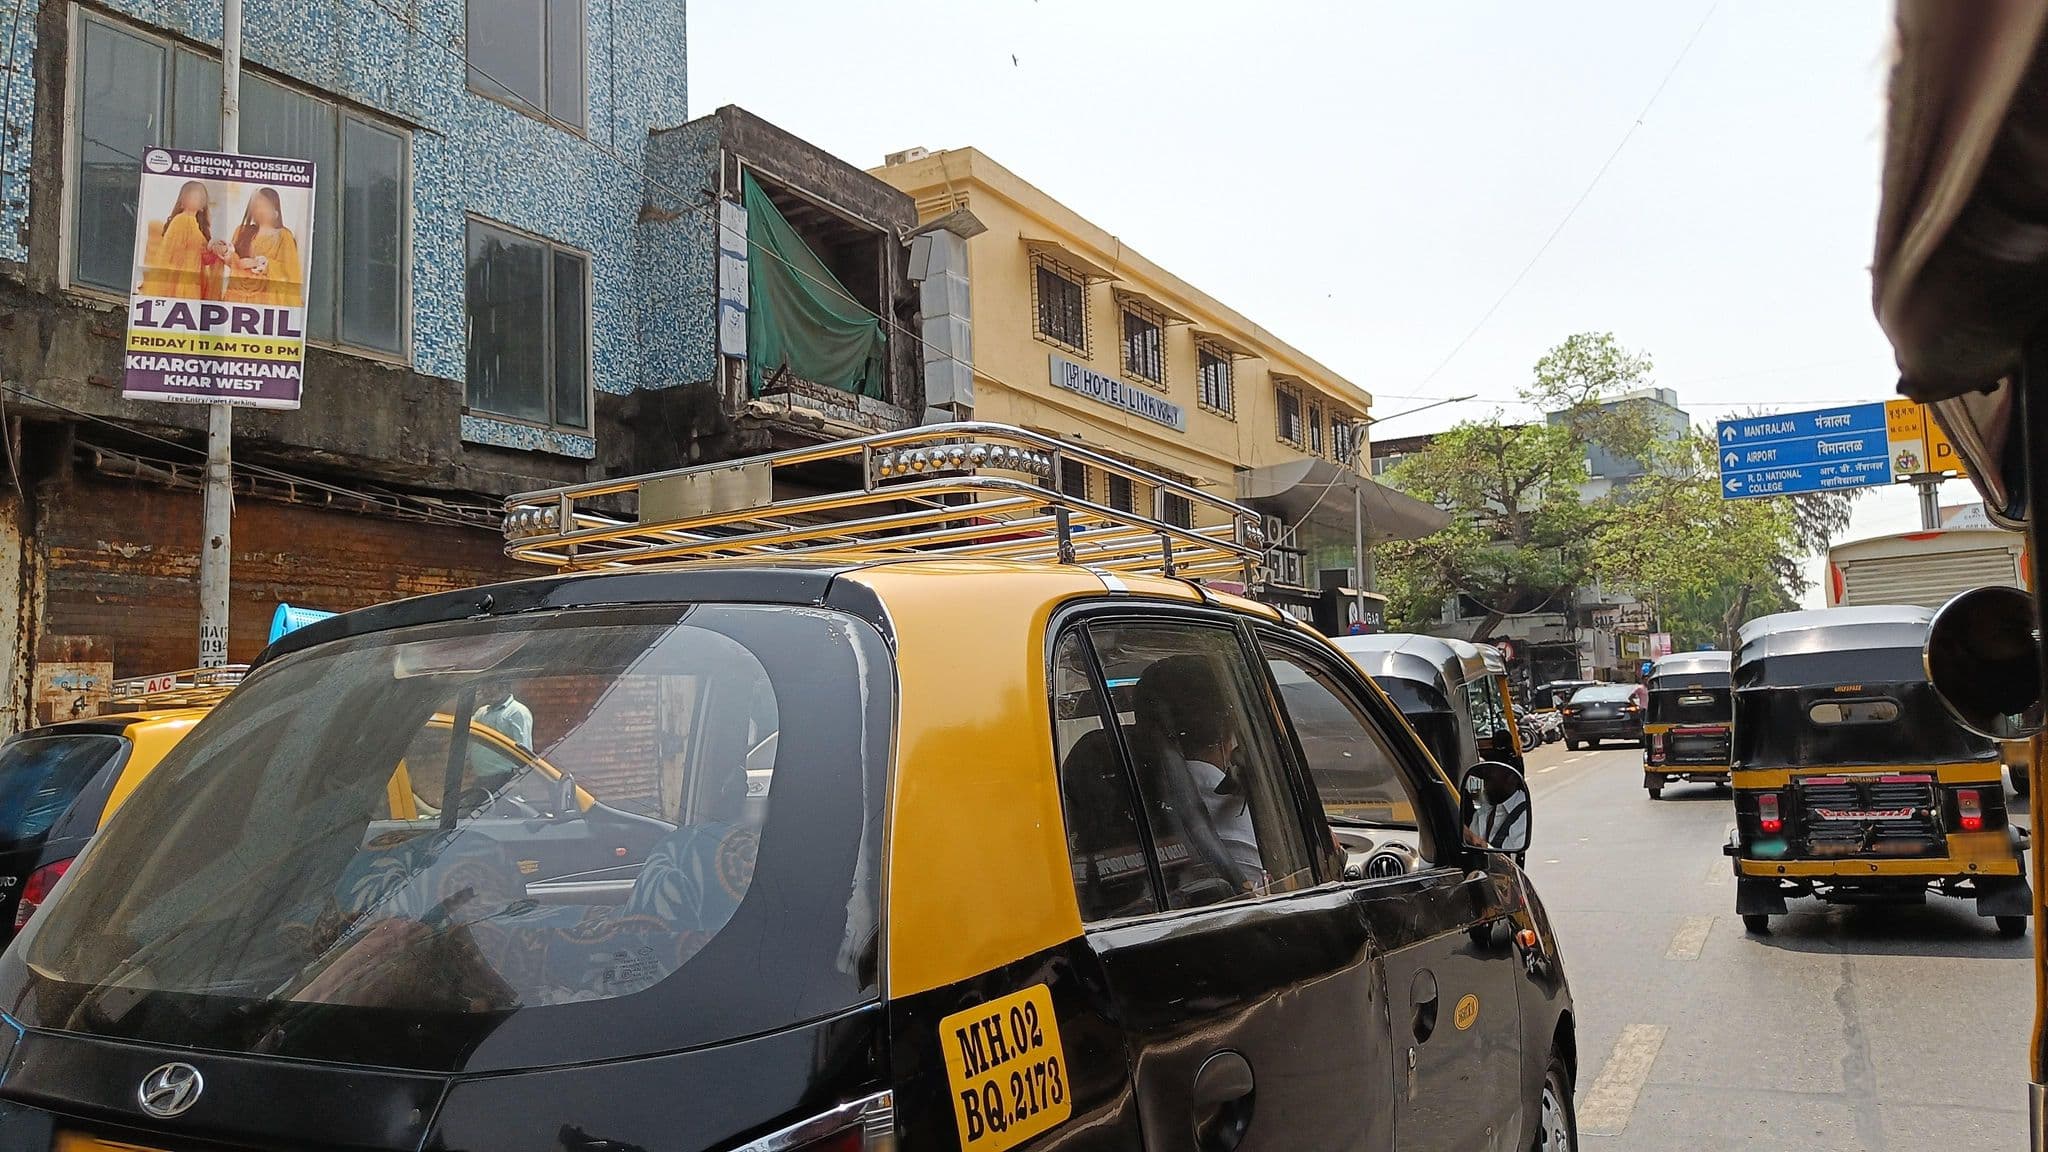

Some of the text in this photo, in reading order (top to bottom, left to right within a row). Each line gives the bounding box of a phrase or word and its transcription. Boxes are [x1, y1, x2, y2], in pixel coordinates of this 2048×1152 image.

[171, 163, 310, 183] & LIFESTYLE EXHIBITION
[178, 154, 235, 169] FASHION,
[235, 160, 305, 174] TROUSSEAU
[161, 302, 302, 338] APRIL
[131, 335, 186, 349] FRIDAY
[198, 340, 209, 350] 11
[214, 342, 237, 353] AM
[240, 344, 260, 353] TO
[264, 345, 273, 354] 8
[277, 346, 299, 356] PM
[126, 354, 300, 380] KHARGYMKHANA
[164, 374, 264, 391] KHAR WEST
[1083, 370, 1126, 404] HOTEL
[1744, 421, 1796, 437] MANTRALAYA
[1814, 414, 1852, 429] मंत्रालय
[1746, 449, 1777, 464] AIRPORT
[1817, 440, 1864, 456] विमानतळ
[1765, 469, 1802, 481] NATIONAL
[1748, 481, 1784, 493] COLLEGE
[147, 677, 171, 692] A/C
[955, 1000, 1043, 1080] MH.02
[960, 1055, 1063, 1143] BQ.2173
